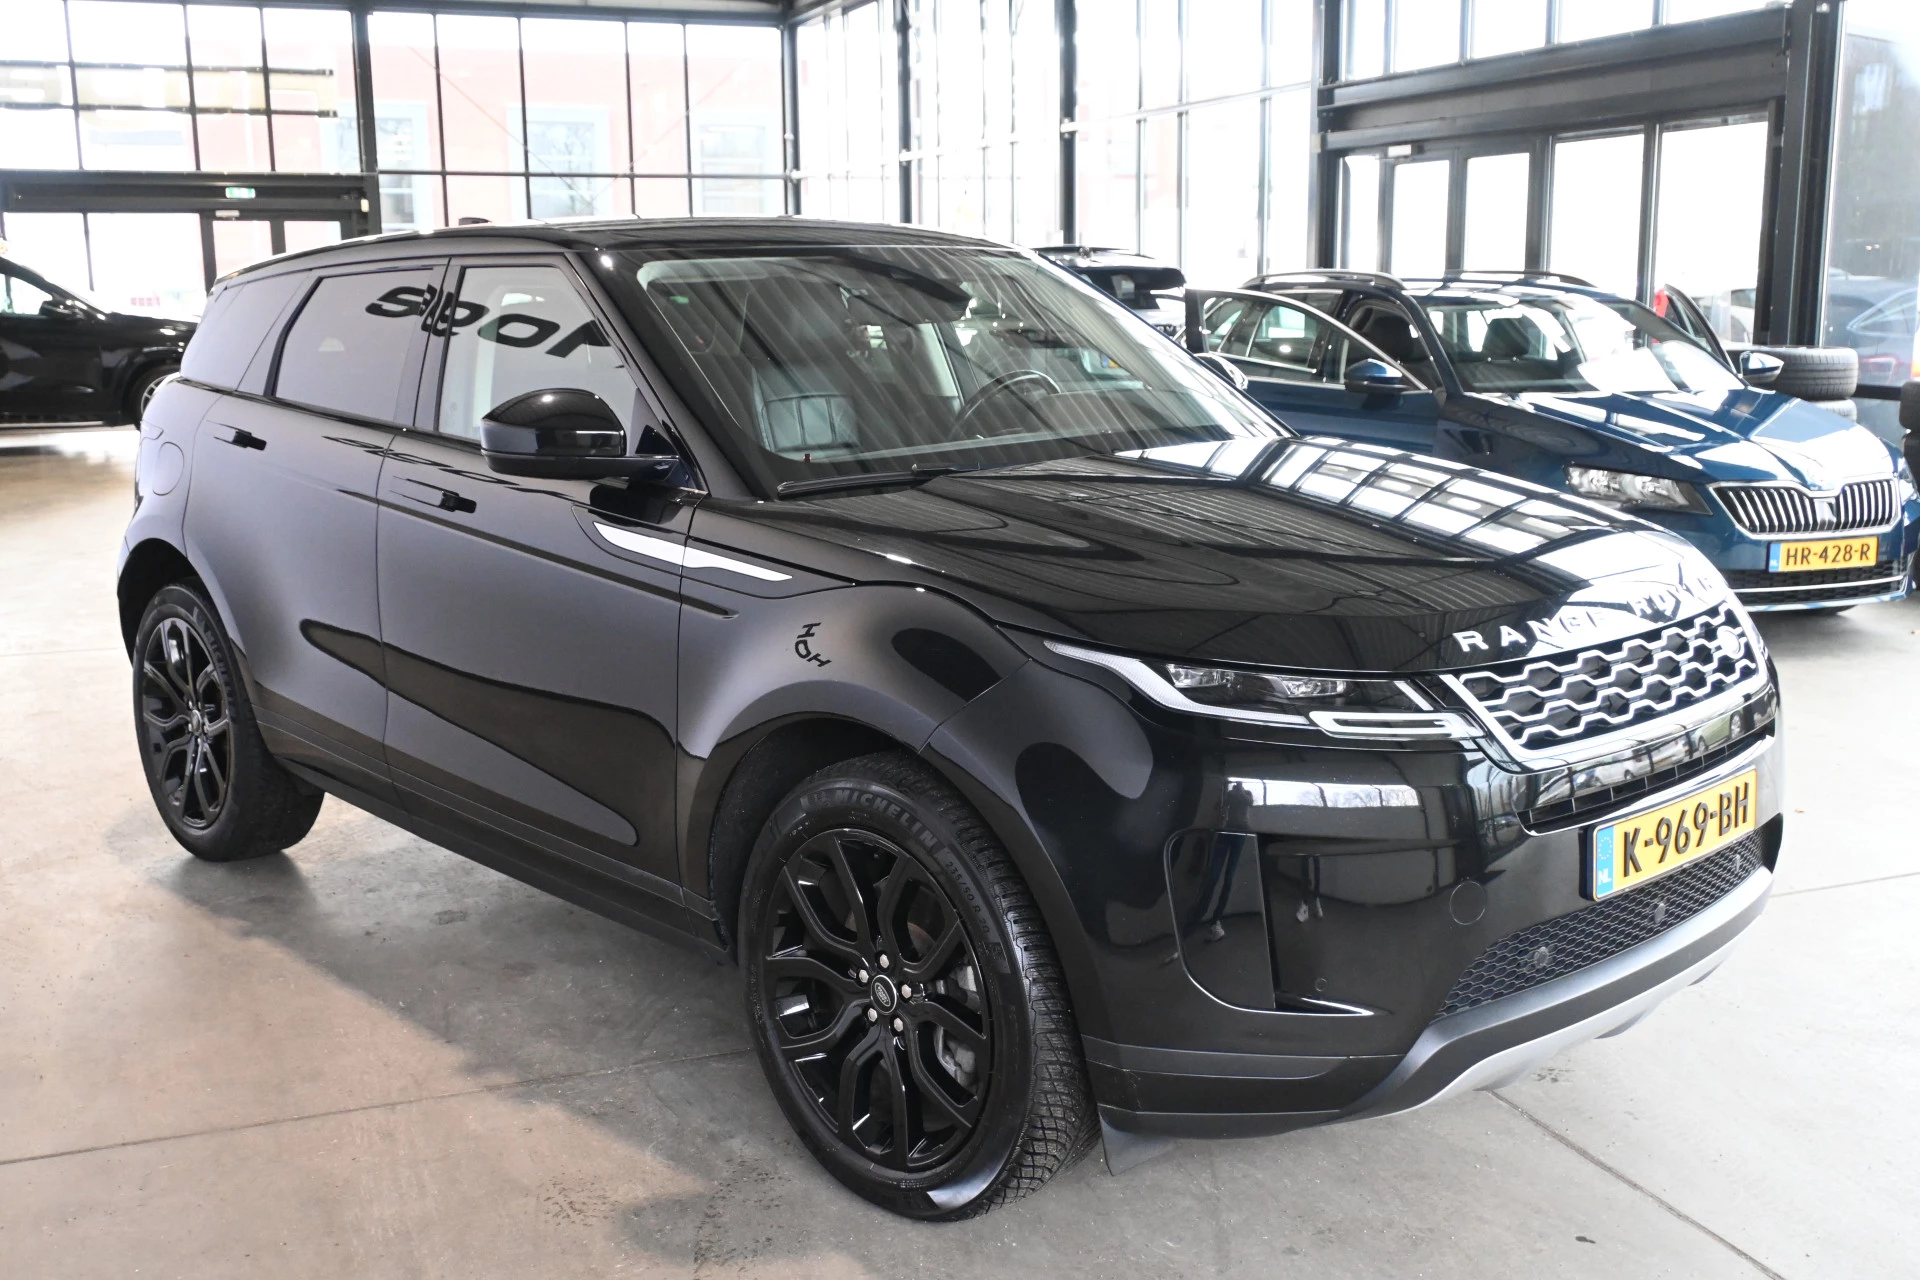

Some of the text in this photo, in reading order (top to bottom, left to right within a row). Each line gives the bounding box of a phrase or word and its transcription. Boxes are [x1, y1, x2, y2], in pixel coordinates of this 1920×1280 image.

[1785, 543, 1871, 566] HR-428-R
[834, 788, 939, 851] MICHELIN
[1597, 781, 1750, 885] NL K-969-BH
[944, 861, 975, 901] 235/50
